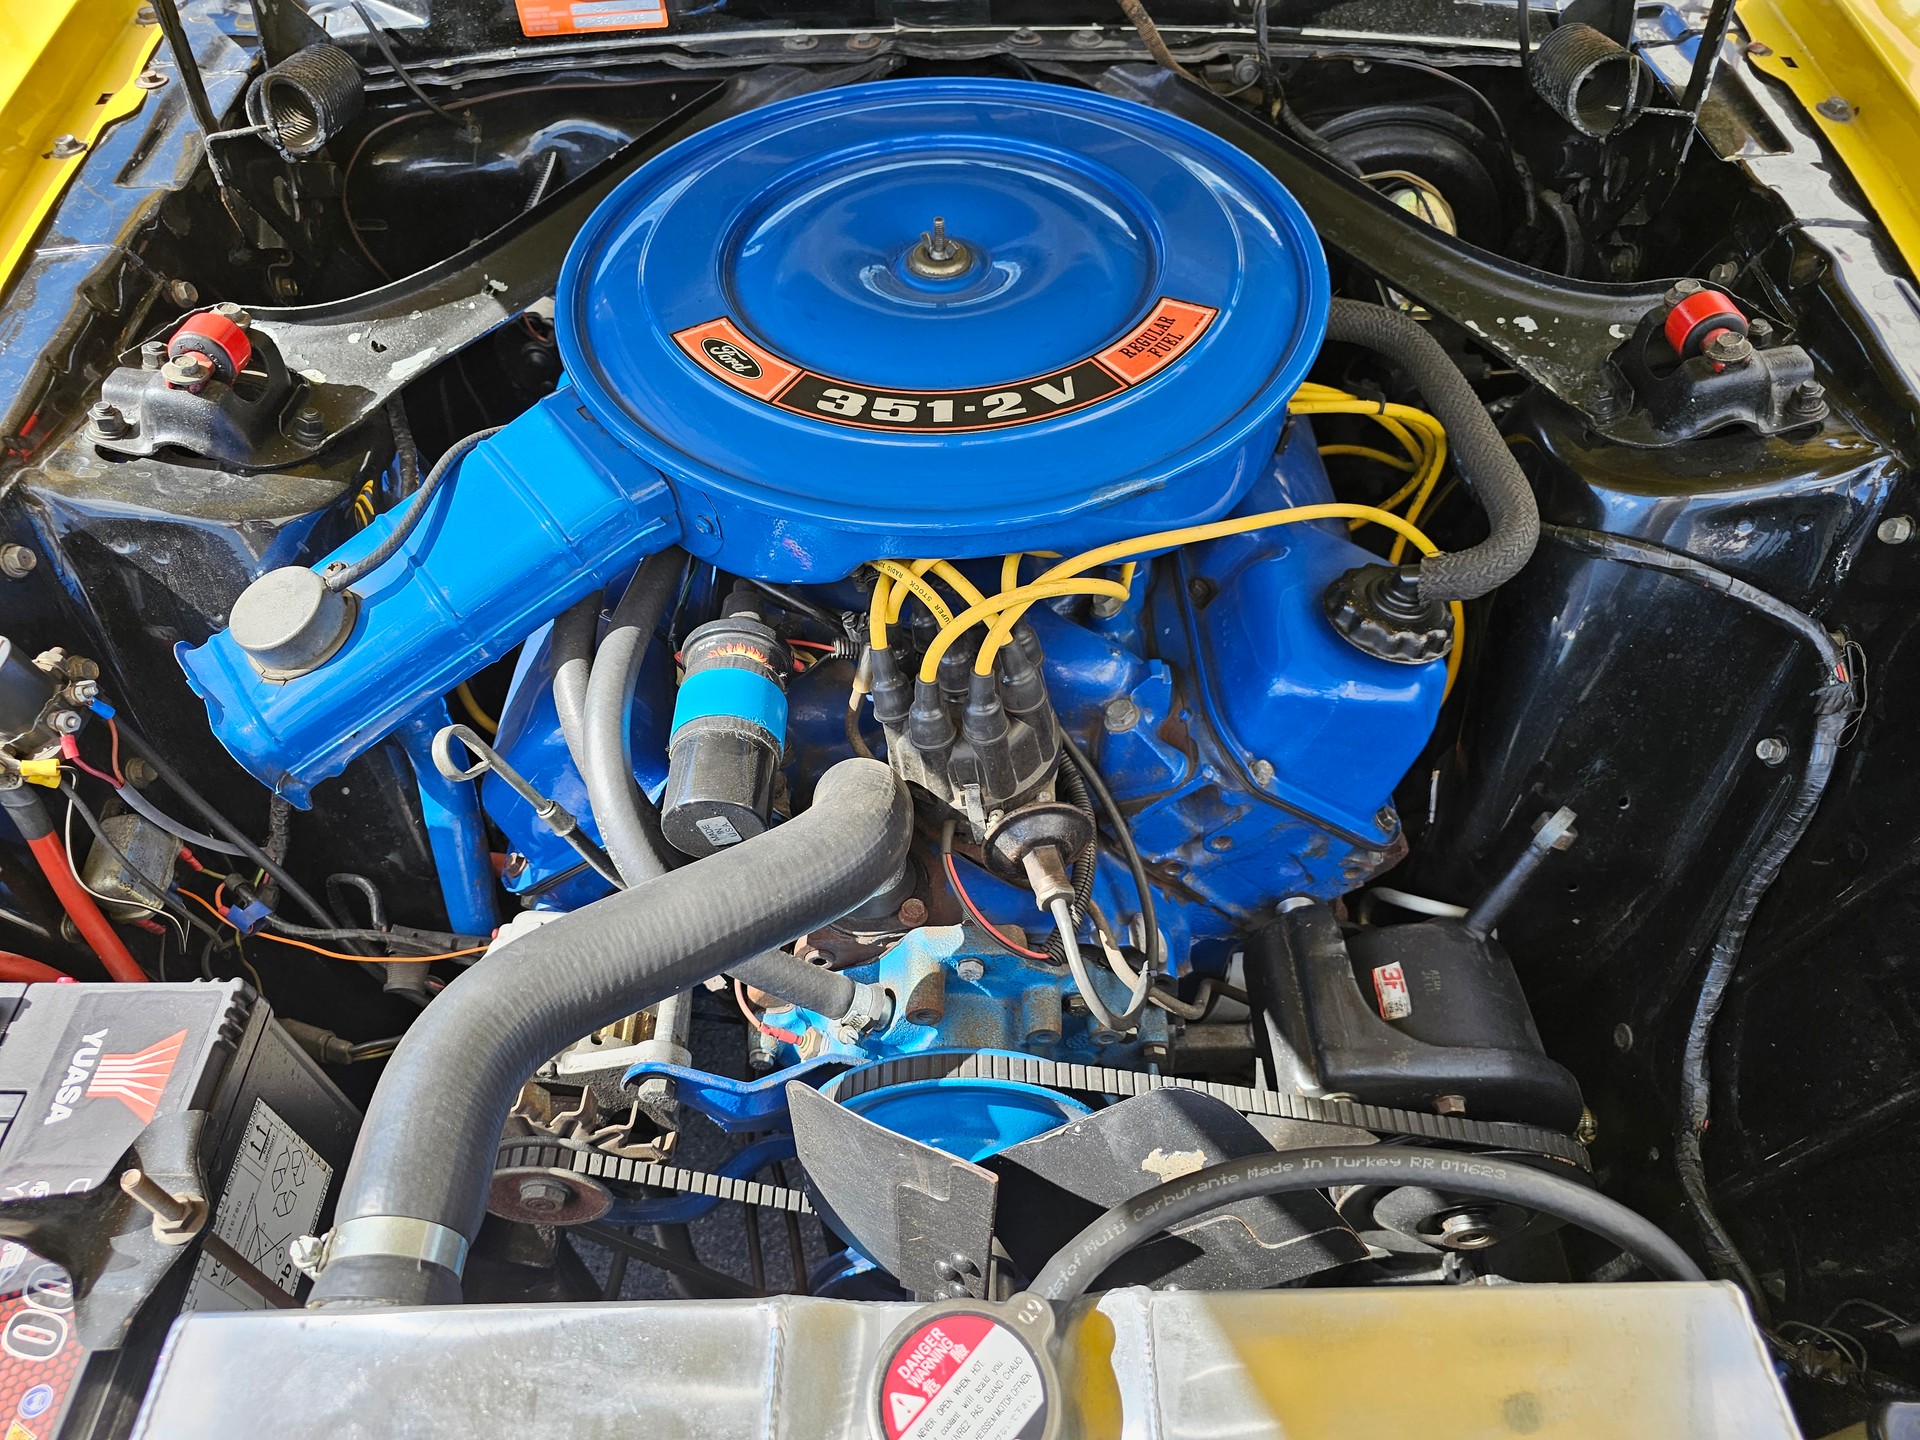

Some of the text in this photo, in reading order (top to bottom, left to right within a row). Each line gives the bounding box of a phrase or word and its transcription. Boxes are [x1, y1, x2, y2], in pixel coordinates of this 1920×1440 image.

[709, 344, 753, 373] Ford
[1118, 315, 1177, 359] REGULAR
[1146, 332, 1185, 359] FUEL
[887, 565, 952, 626] UPER STOCK RADIO
[701, 824, 720, 842] MADE
[721, 822, 738, 838] USA
[43, 1027, 109, 1126] YUASA
[225, 1200, 242, 1240] 016780
[1085, 1218, 1127, 1258] Multi
[1133, 1172, 1240, 1223] Carburante
[1246, 1160, 1294, 1181] Made
[1302, 1157, 1323, 1170] In
[1330, 1155, 1402, 1169] Turkey
[1409, 1156, 1435, 1170] RR
[1441, 1160, 1507, 1181] 011623
[896, 1326, 946, 1380] DANGER
[905, 1336, 954, 1389] WARNING
[916, 1417, 938, 1440] NEVER
[936, 1396, 954, 1417] OPEN
[952, 1376, 972, 1396] WHEN
[940, 1411, 962, 1436] coolant
[961, 1393, 975, 1410] will
[975, 1374, 991, 1394] scald
[970, 1404, 985, 1420] PAS
[983, 1379, 1005, 1404] QUAND
[995, 1393, 1015, 1418] MOTOR
